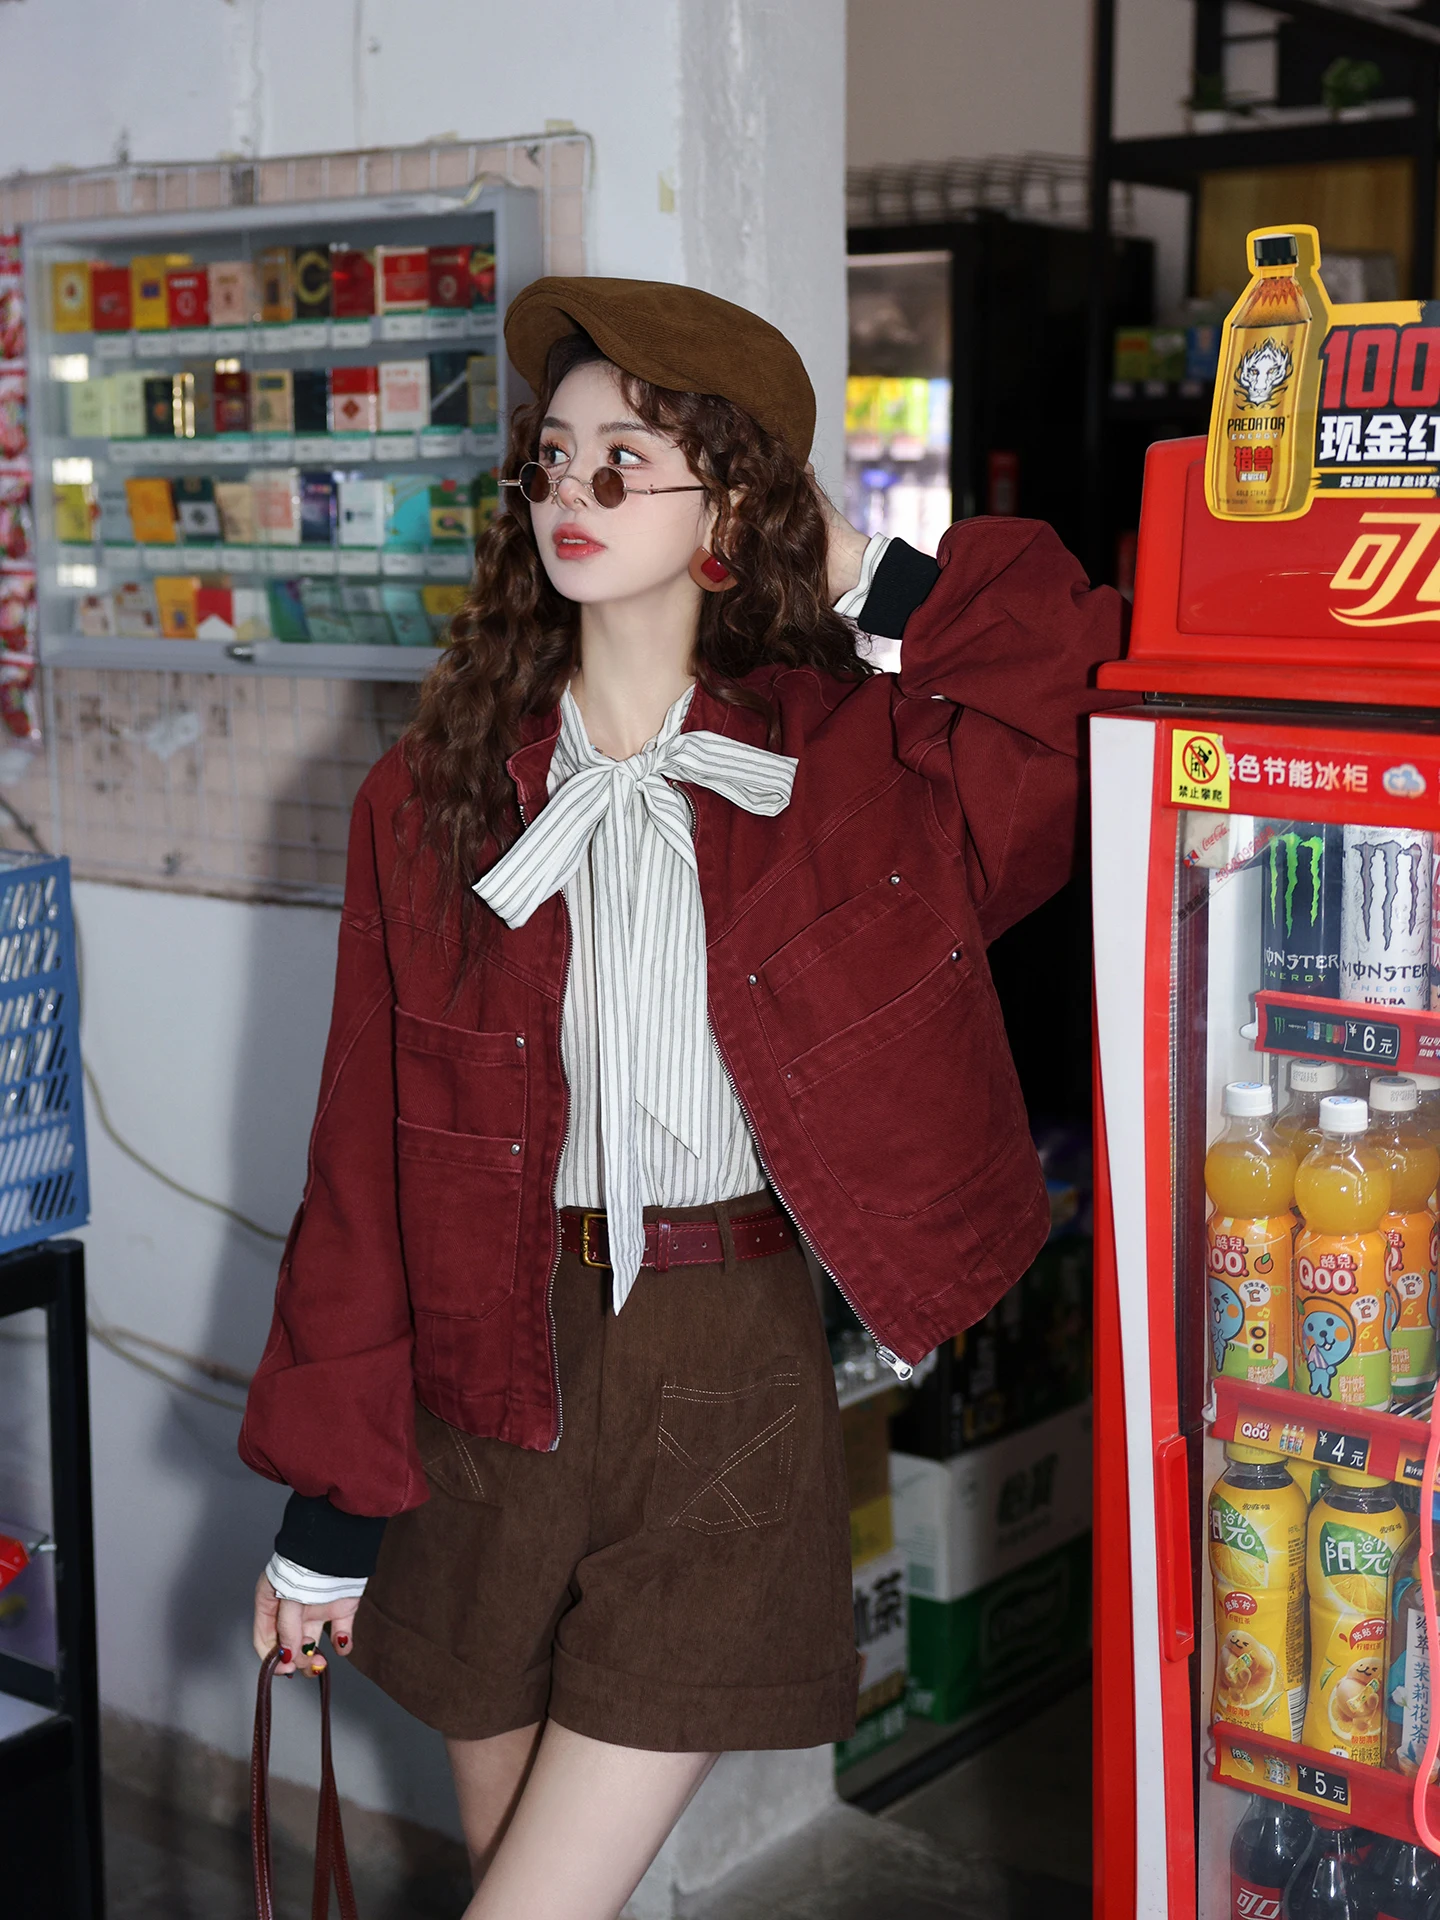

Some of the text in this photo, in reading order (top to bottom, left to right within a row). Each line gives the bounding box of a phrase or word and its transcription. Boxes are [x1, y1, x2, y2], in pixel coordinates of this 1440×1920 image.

[1323, 327, 1440, 409] 100
[1227, 416, 1286, 439] PREDATOR
[1231, 432, 1278, 440] ENERGY
[1319, 414, 1440, 462] 现金红
[1233, 446, 1273, 483] 猎兽
[1328, 511, 1440, 616] 可
[1179, 785, 1222, 802] 禁止攀爬
[1341, 960, 1429, 982] MONSTER
[1351, 983, 1420, 994] ENERGY
[1364, 996, 1406, 1006] ULTRA
[1320, 1254, 1351, 1269] 酷兒
[1410, 1661, 1430, 1745] 茉莉花茶
